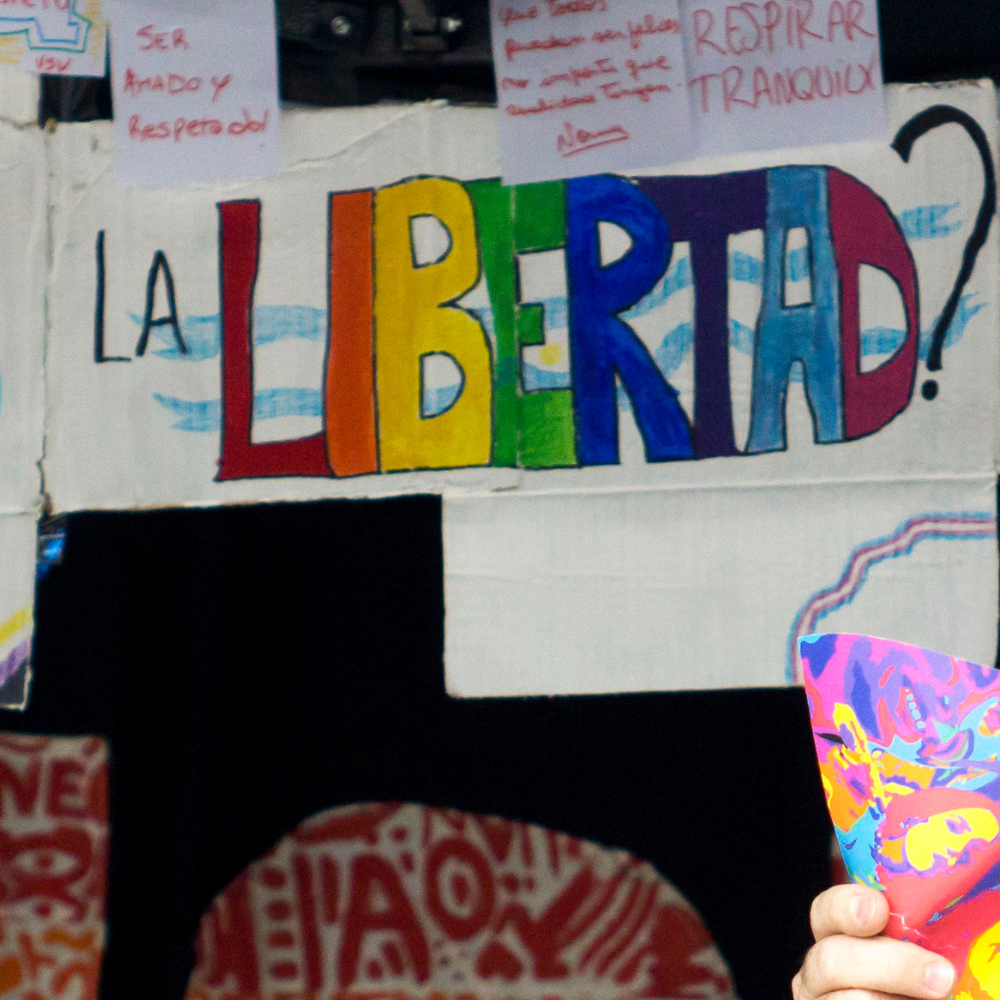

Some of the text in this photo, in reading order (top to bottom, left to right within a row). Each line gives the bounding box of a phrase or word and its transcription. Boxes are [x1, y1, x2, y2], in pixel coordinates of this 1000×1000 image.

[136, 25, 189, 51] SER
[692, 0, 876, 56] RESPIRAR
[95, 228, 188, 363] LA
